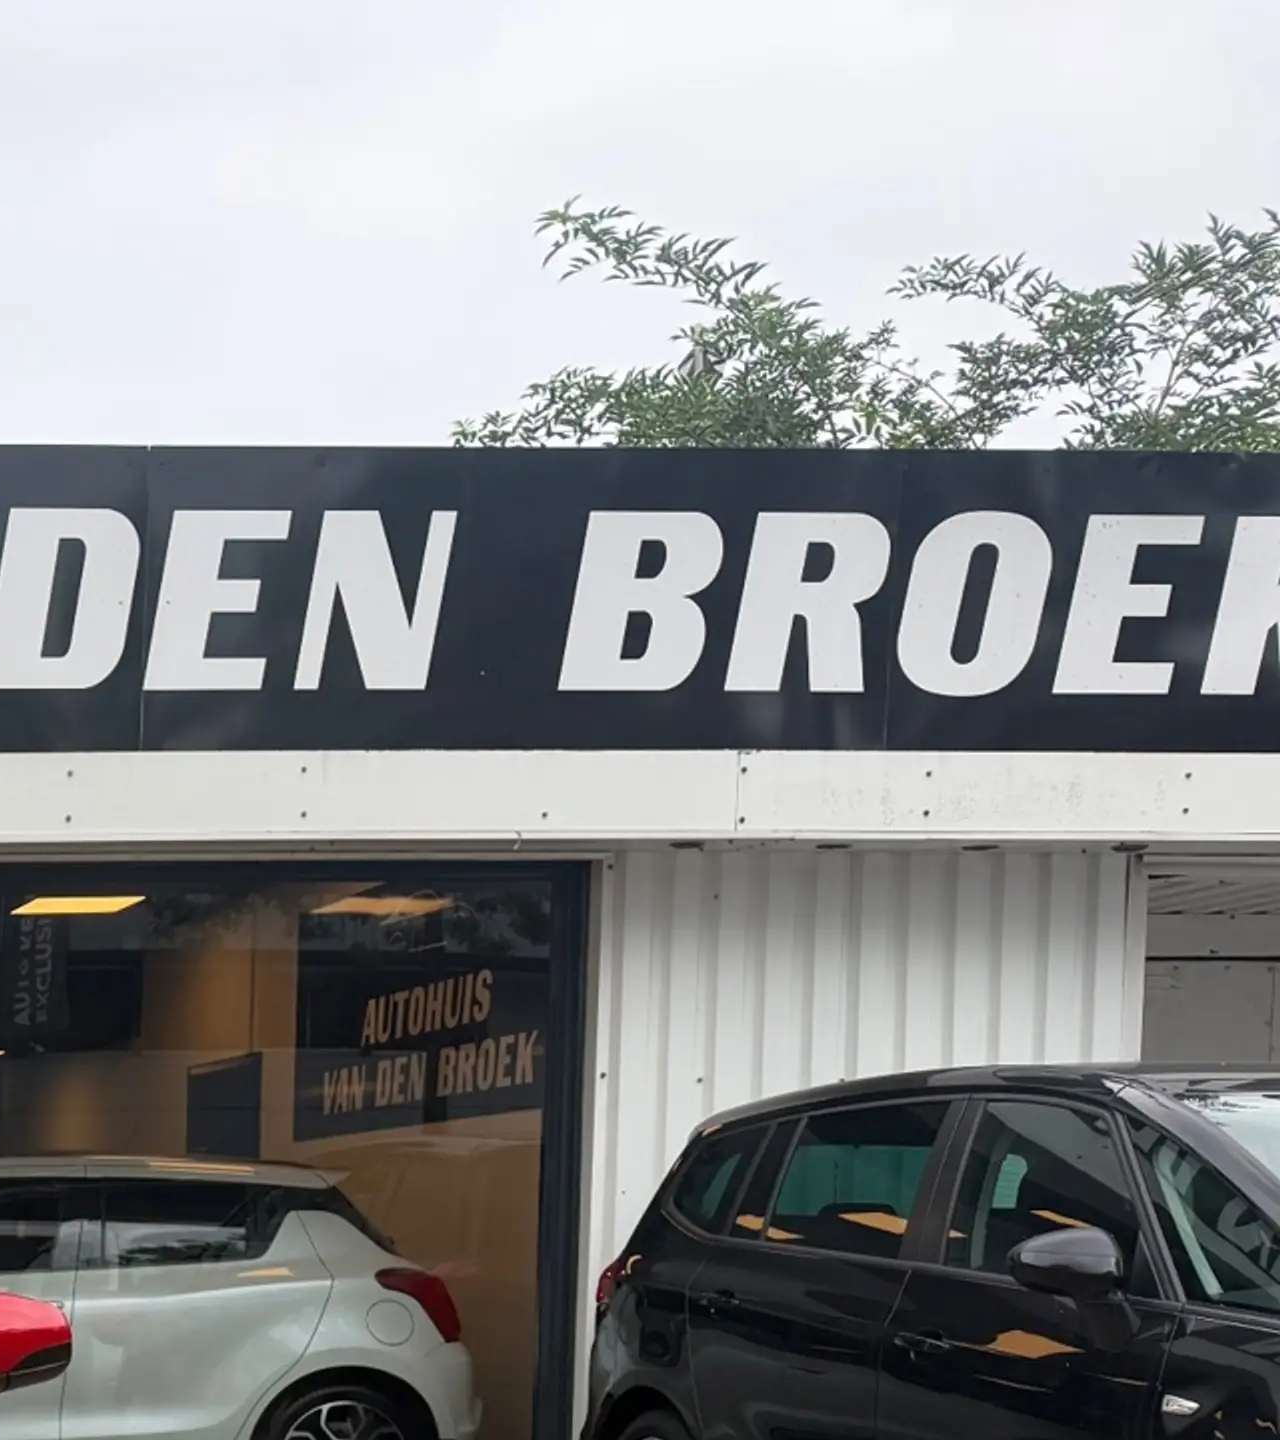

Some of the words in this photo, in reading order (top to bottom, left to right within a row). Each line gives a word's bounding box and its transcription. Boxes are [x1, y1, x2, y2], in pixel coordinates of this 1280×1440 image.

[361, 969, 493, 1046] AUTOHUIS
[323, 1064, 366, 1115] VAN
[375, 1052, 427, 1107] DEN
[436, 1030, 538, 1097] BROEK
